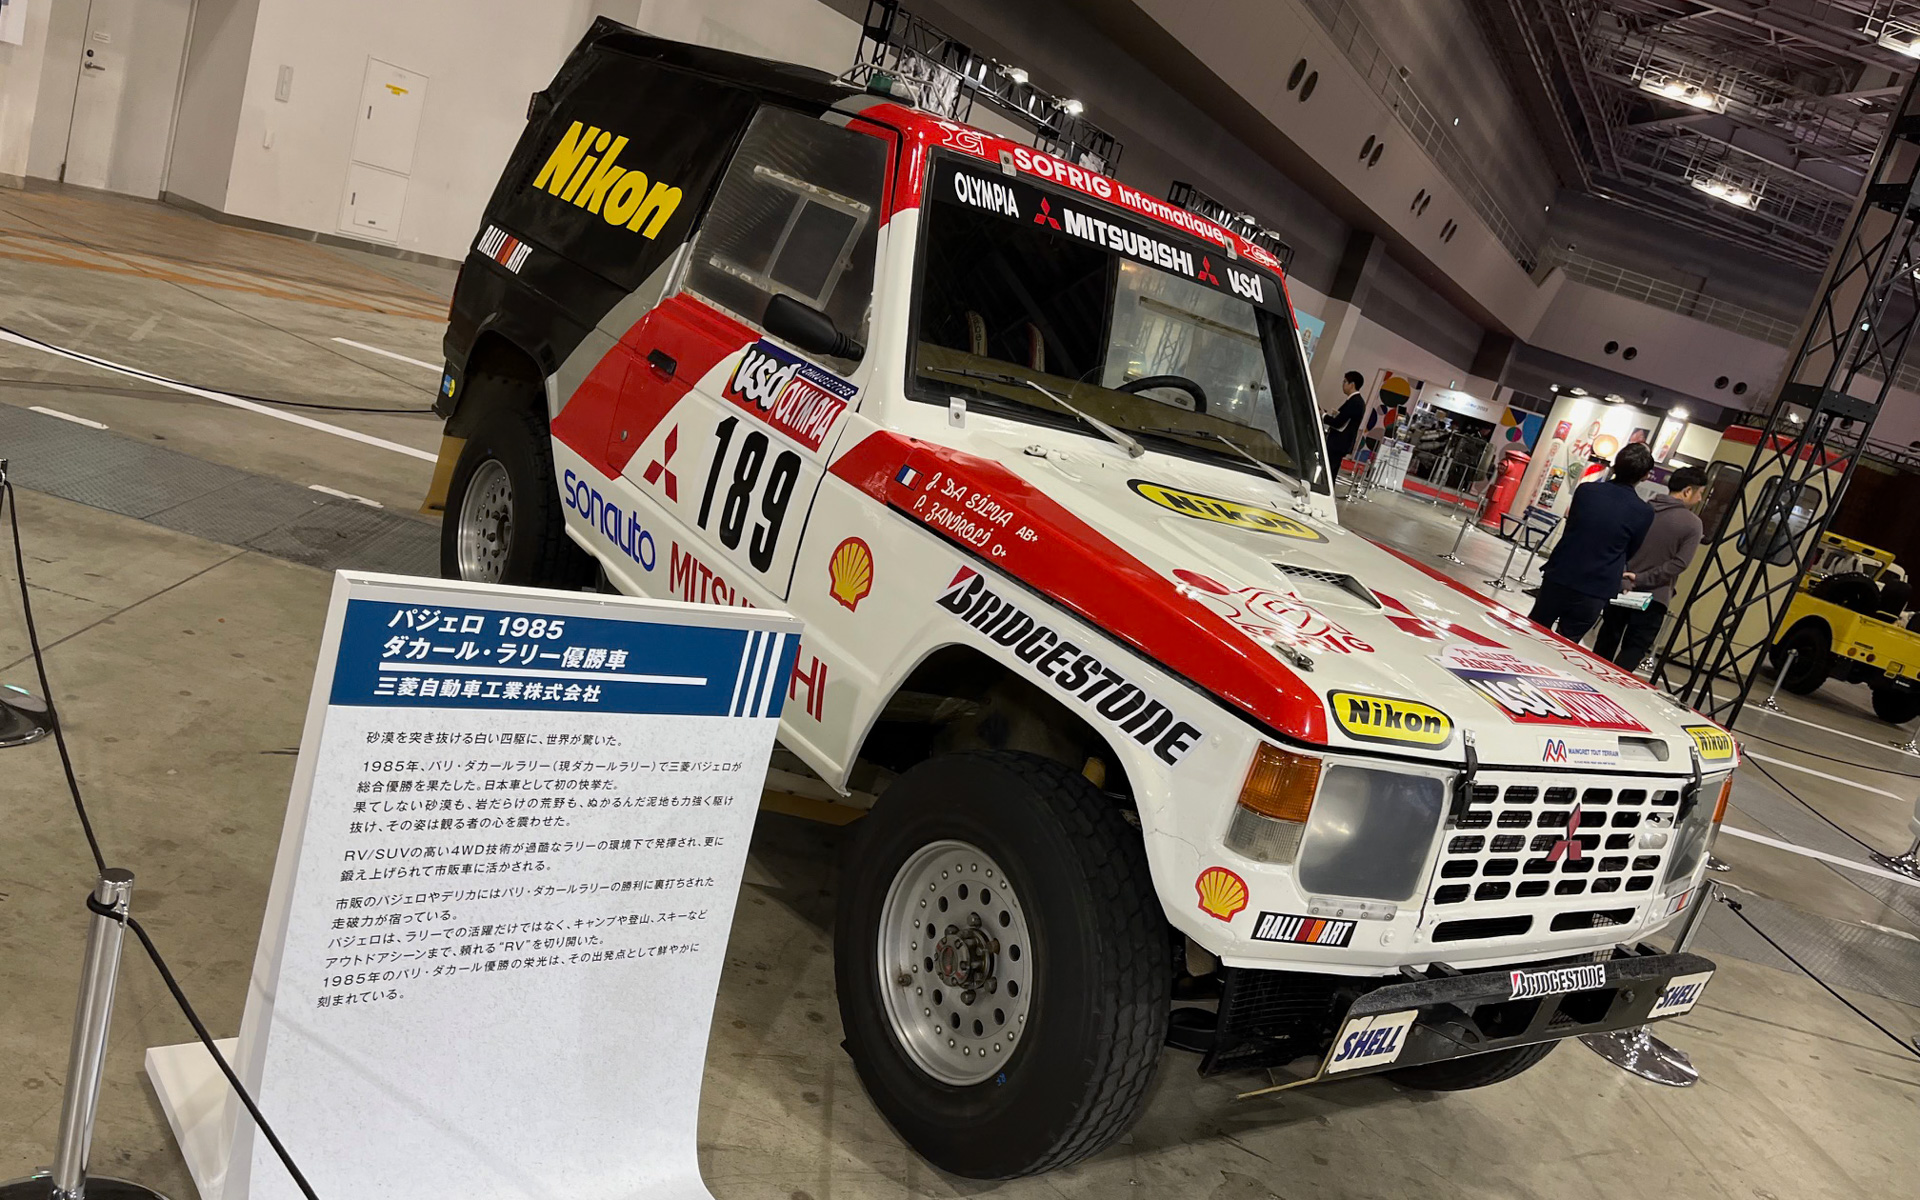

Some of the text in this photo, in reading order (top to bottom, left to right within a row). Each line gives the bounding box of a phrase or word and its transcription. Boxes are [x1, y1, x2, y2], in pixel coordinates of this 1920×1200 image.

[532, 120, 683, 240] Nikon
[954, 171, 1020, 219] OLYMPIA
[1013, 147, 1226, 246] SOFRIG Informatique
[1063, 208, 1196, 277] MITSUBISHI
[775, 381, 841, 439] OLYMPIA
[697, 415, 802, 574] 189
[940, 477, 968, 502] DA
[563, 468, 656, 572] sonauto
[1160, 491, 1304, 534] Nikon
[387, 608, 566, 641] パジェロ 1985
[382, 634, 630, 671] ダカール・ラリー優勝車
[935, 565, 1203, 767] BRIDGESTONE
[373, 676, 602, 704] 三菱自動車工業株式会社
[1347, 698, 1441, 734] Nikon
[1692, 730, 1729, 751] Nikon
[331, 910, 459, 930] 走破力が宿っている。
[316, 990, 405, 1009] 刻まれている。
[1510, 964, 1605, 998] BRIDGESTONE
[1656, 983, 1702, 1010] SHELL
[1334, 1025, 1405, 1062] SHELL
